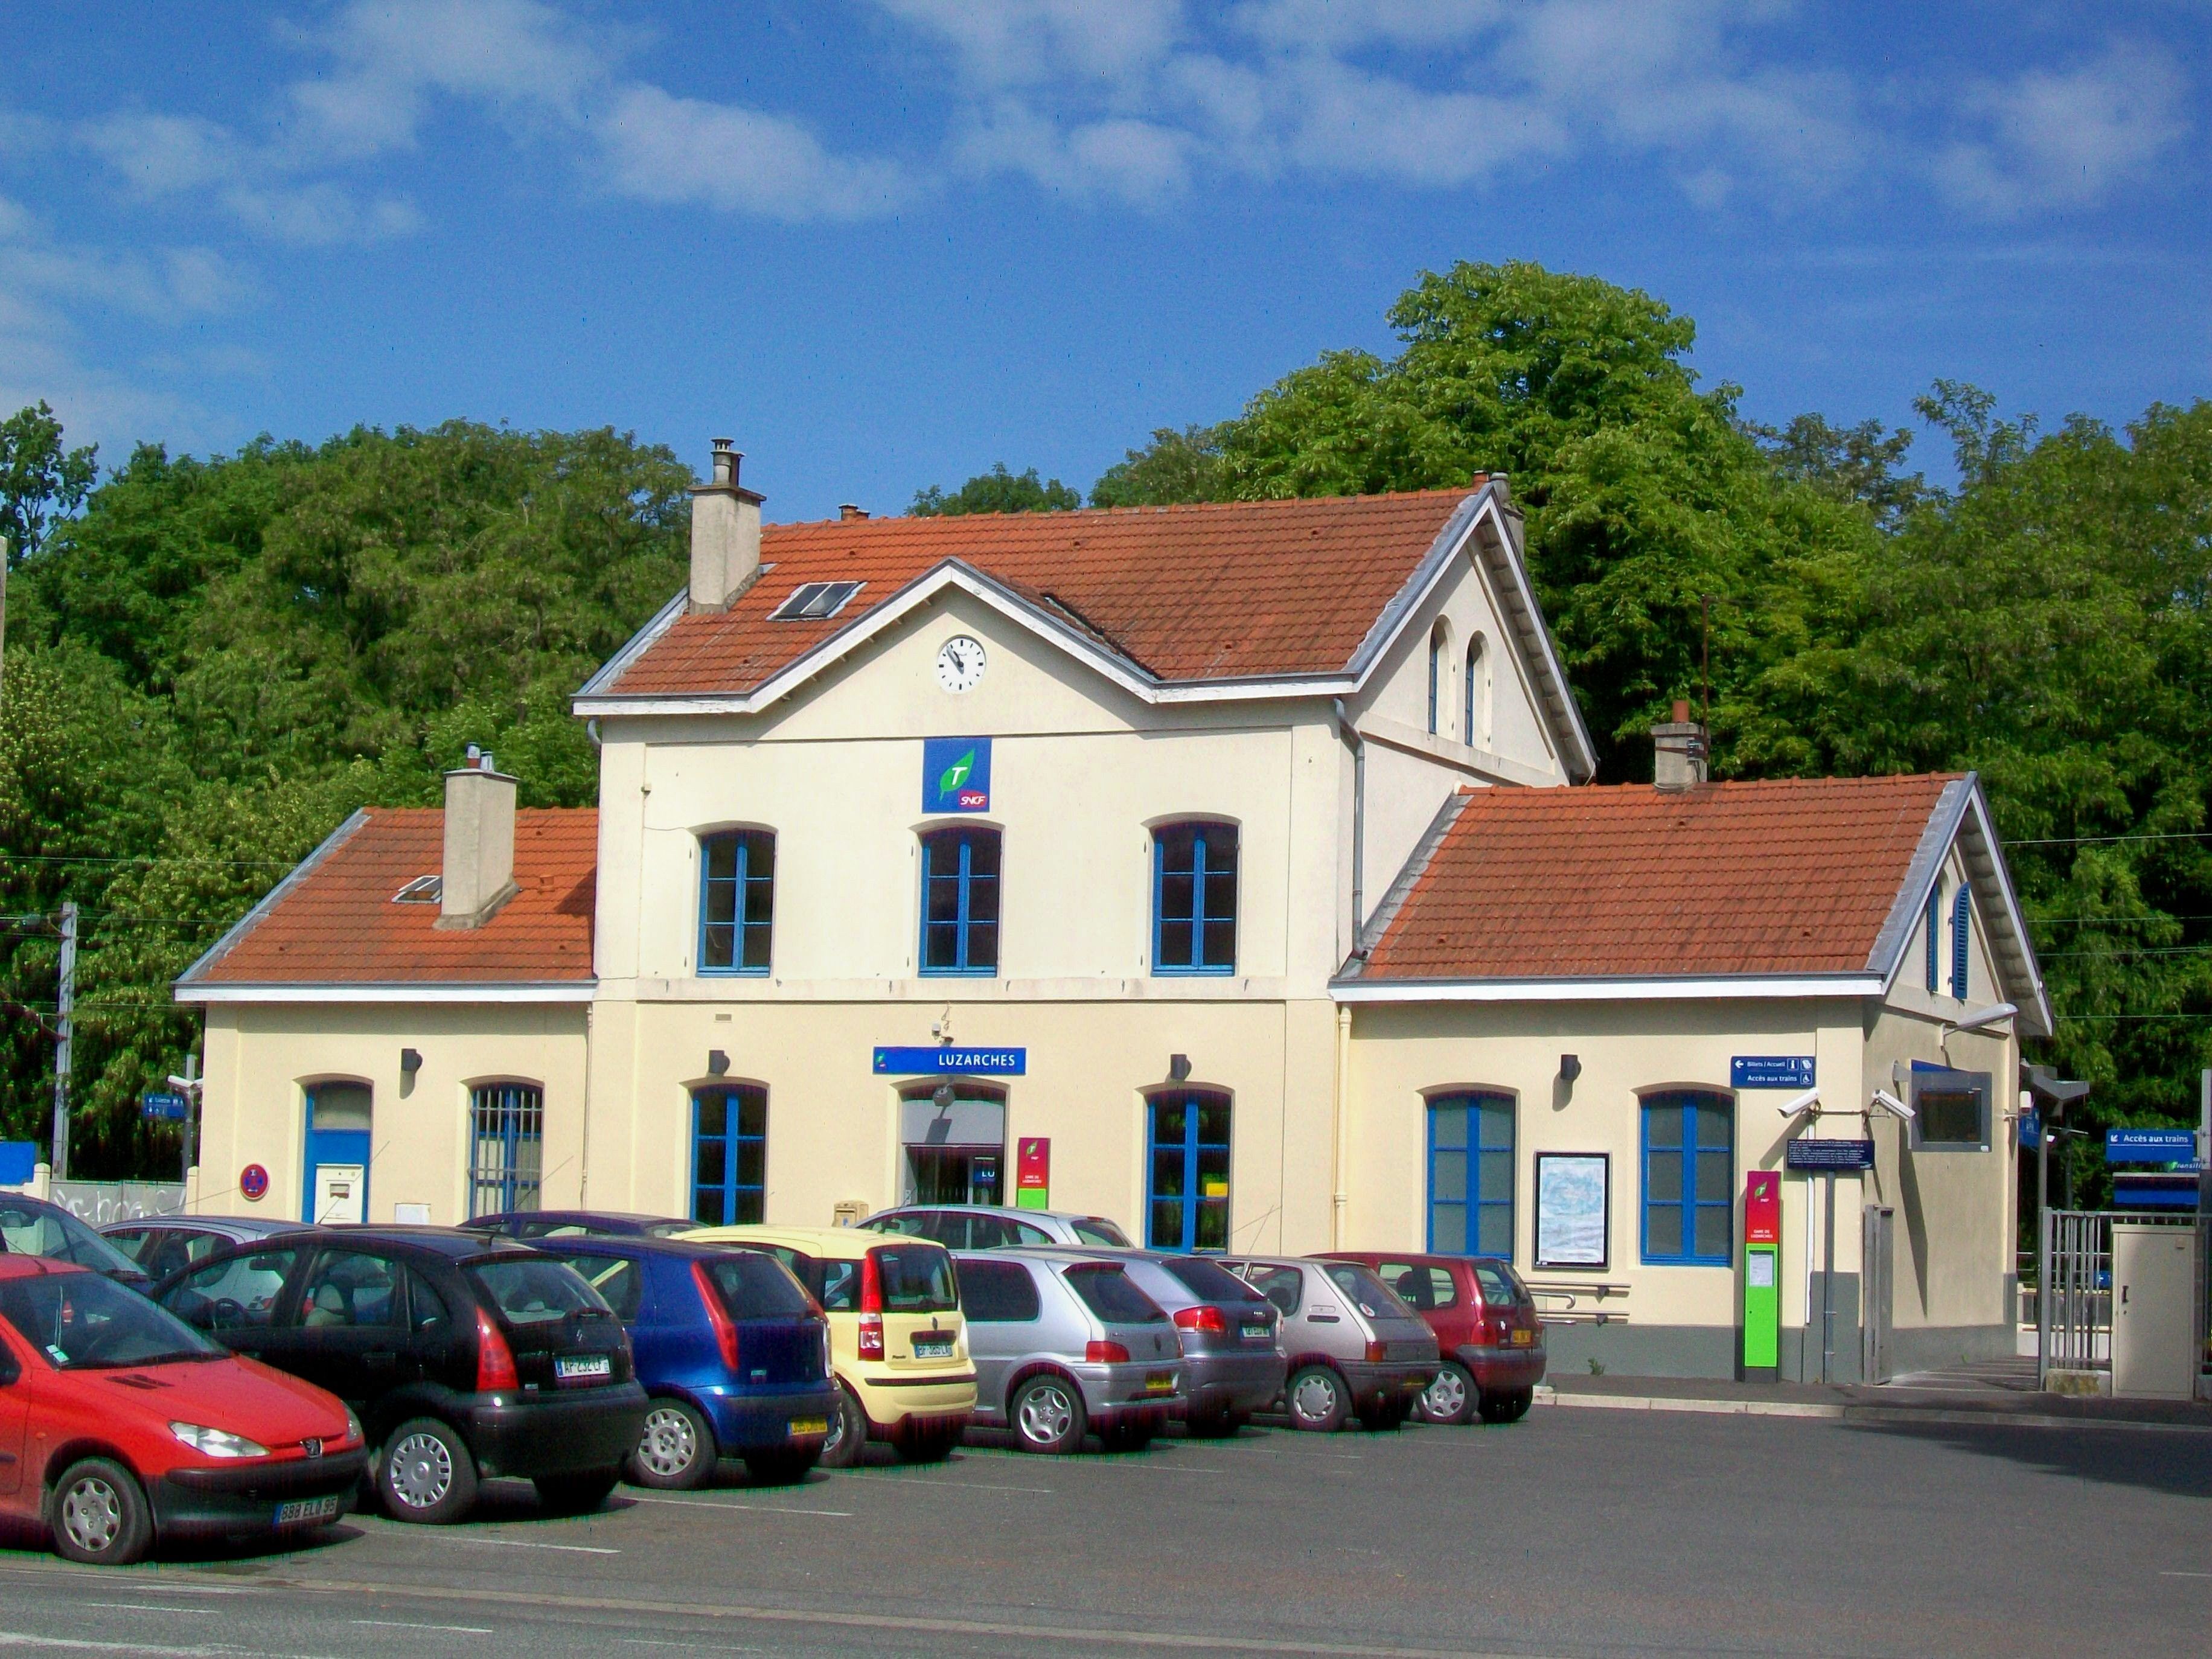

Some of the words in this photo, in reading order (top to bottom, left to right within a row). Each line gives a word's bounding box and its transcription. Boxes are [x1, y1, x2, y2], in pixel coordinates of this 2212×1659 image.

[951, 766, 968, 785] T
[960, 795, 985, 805] SNCF
[939, 1054, 1015, 1066] LUZARCHES
[2123, 1134, 2147, 1142] Accès
